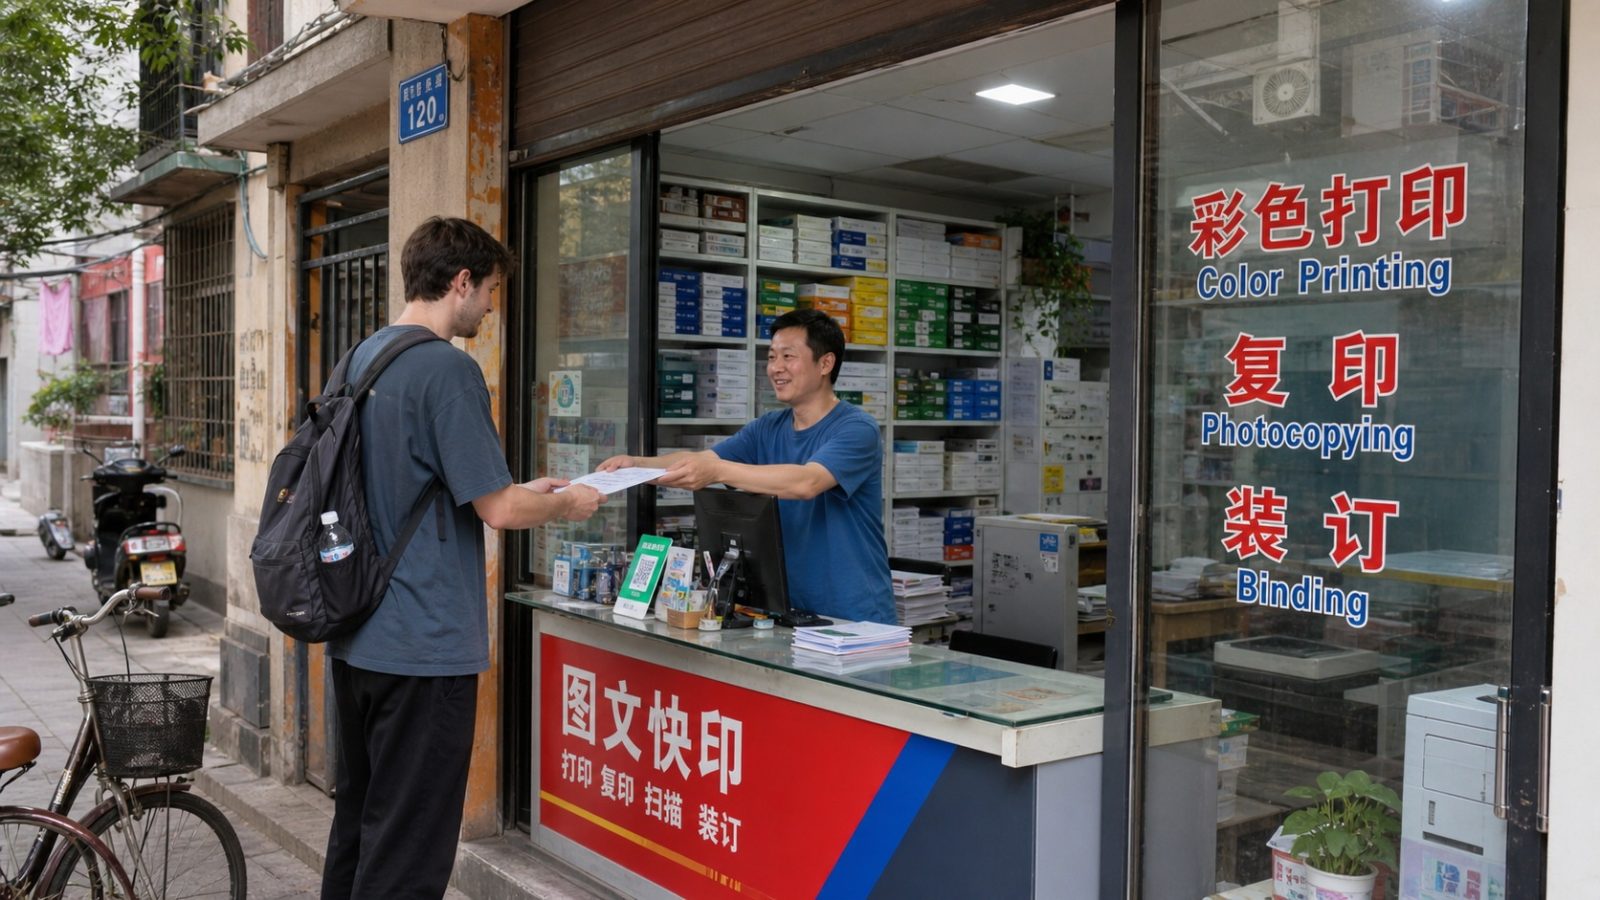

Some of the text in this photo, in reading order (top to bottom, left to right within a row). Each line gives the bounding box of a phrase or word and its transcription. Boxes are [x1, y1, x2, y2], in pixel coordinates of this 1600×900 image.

[407, 95, 437, 130] 120
[1188, 162, 1469, 260] 彩色打印
[1197, 251, 1452, 300] Color Printing
[1201, 411, 1415, 462] Photocopying
[1236, 567, 1369, 629] Binding
[561, 663, 743, 795] 图文快印
[561, 748, 742, 853] 打印 复印 扫描 装订
